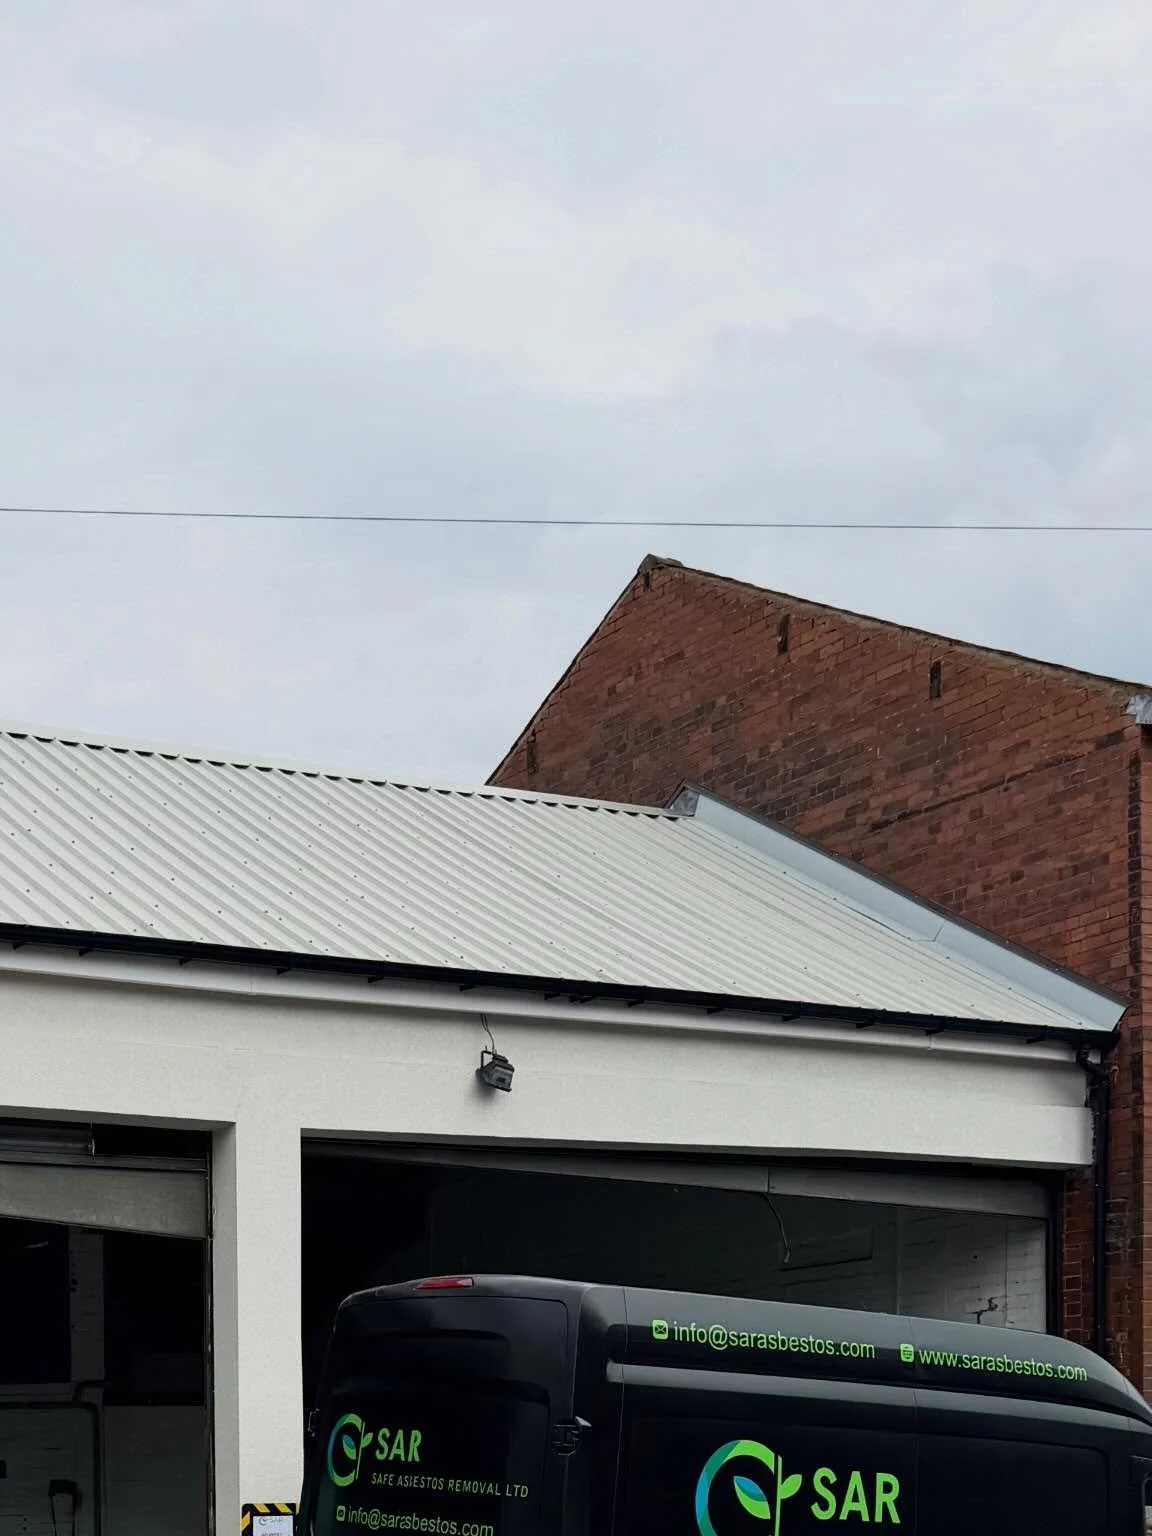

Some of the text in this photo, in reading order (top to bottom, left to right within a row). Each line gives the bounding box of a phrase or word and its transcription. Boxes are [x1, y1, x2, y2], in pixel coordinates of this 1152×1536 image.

[674, 1321, 1087, 1382] info@sarasbestos.com www.sarasbestos.com
[376, 1427, 422, 1463] SAR
[371, 1472, 393, 1486] SAFE
[448, 1479, 501, 1496] REMOVAL
[505, 1484, 529, 1498] LTD
[810, 1466, 901, 1524] SAR
